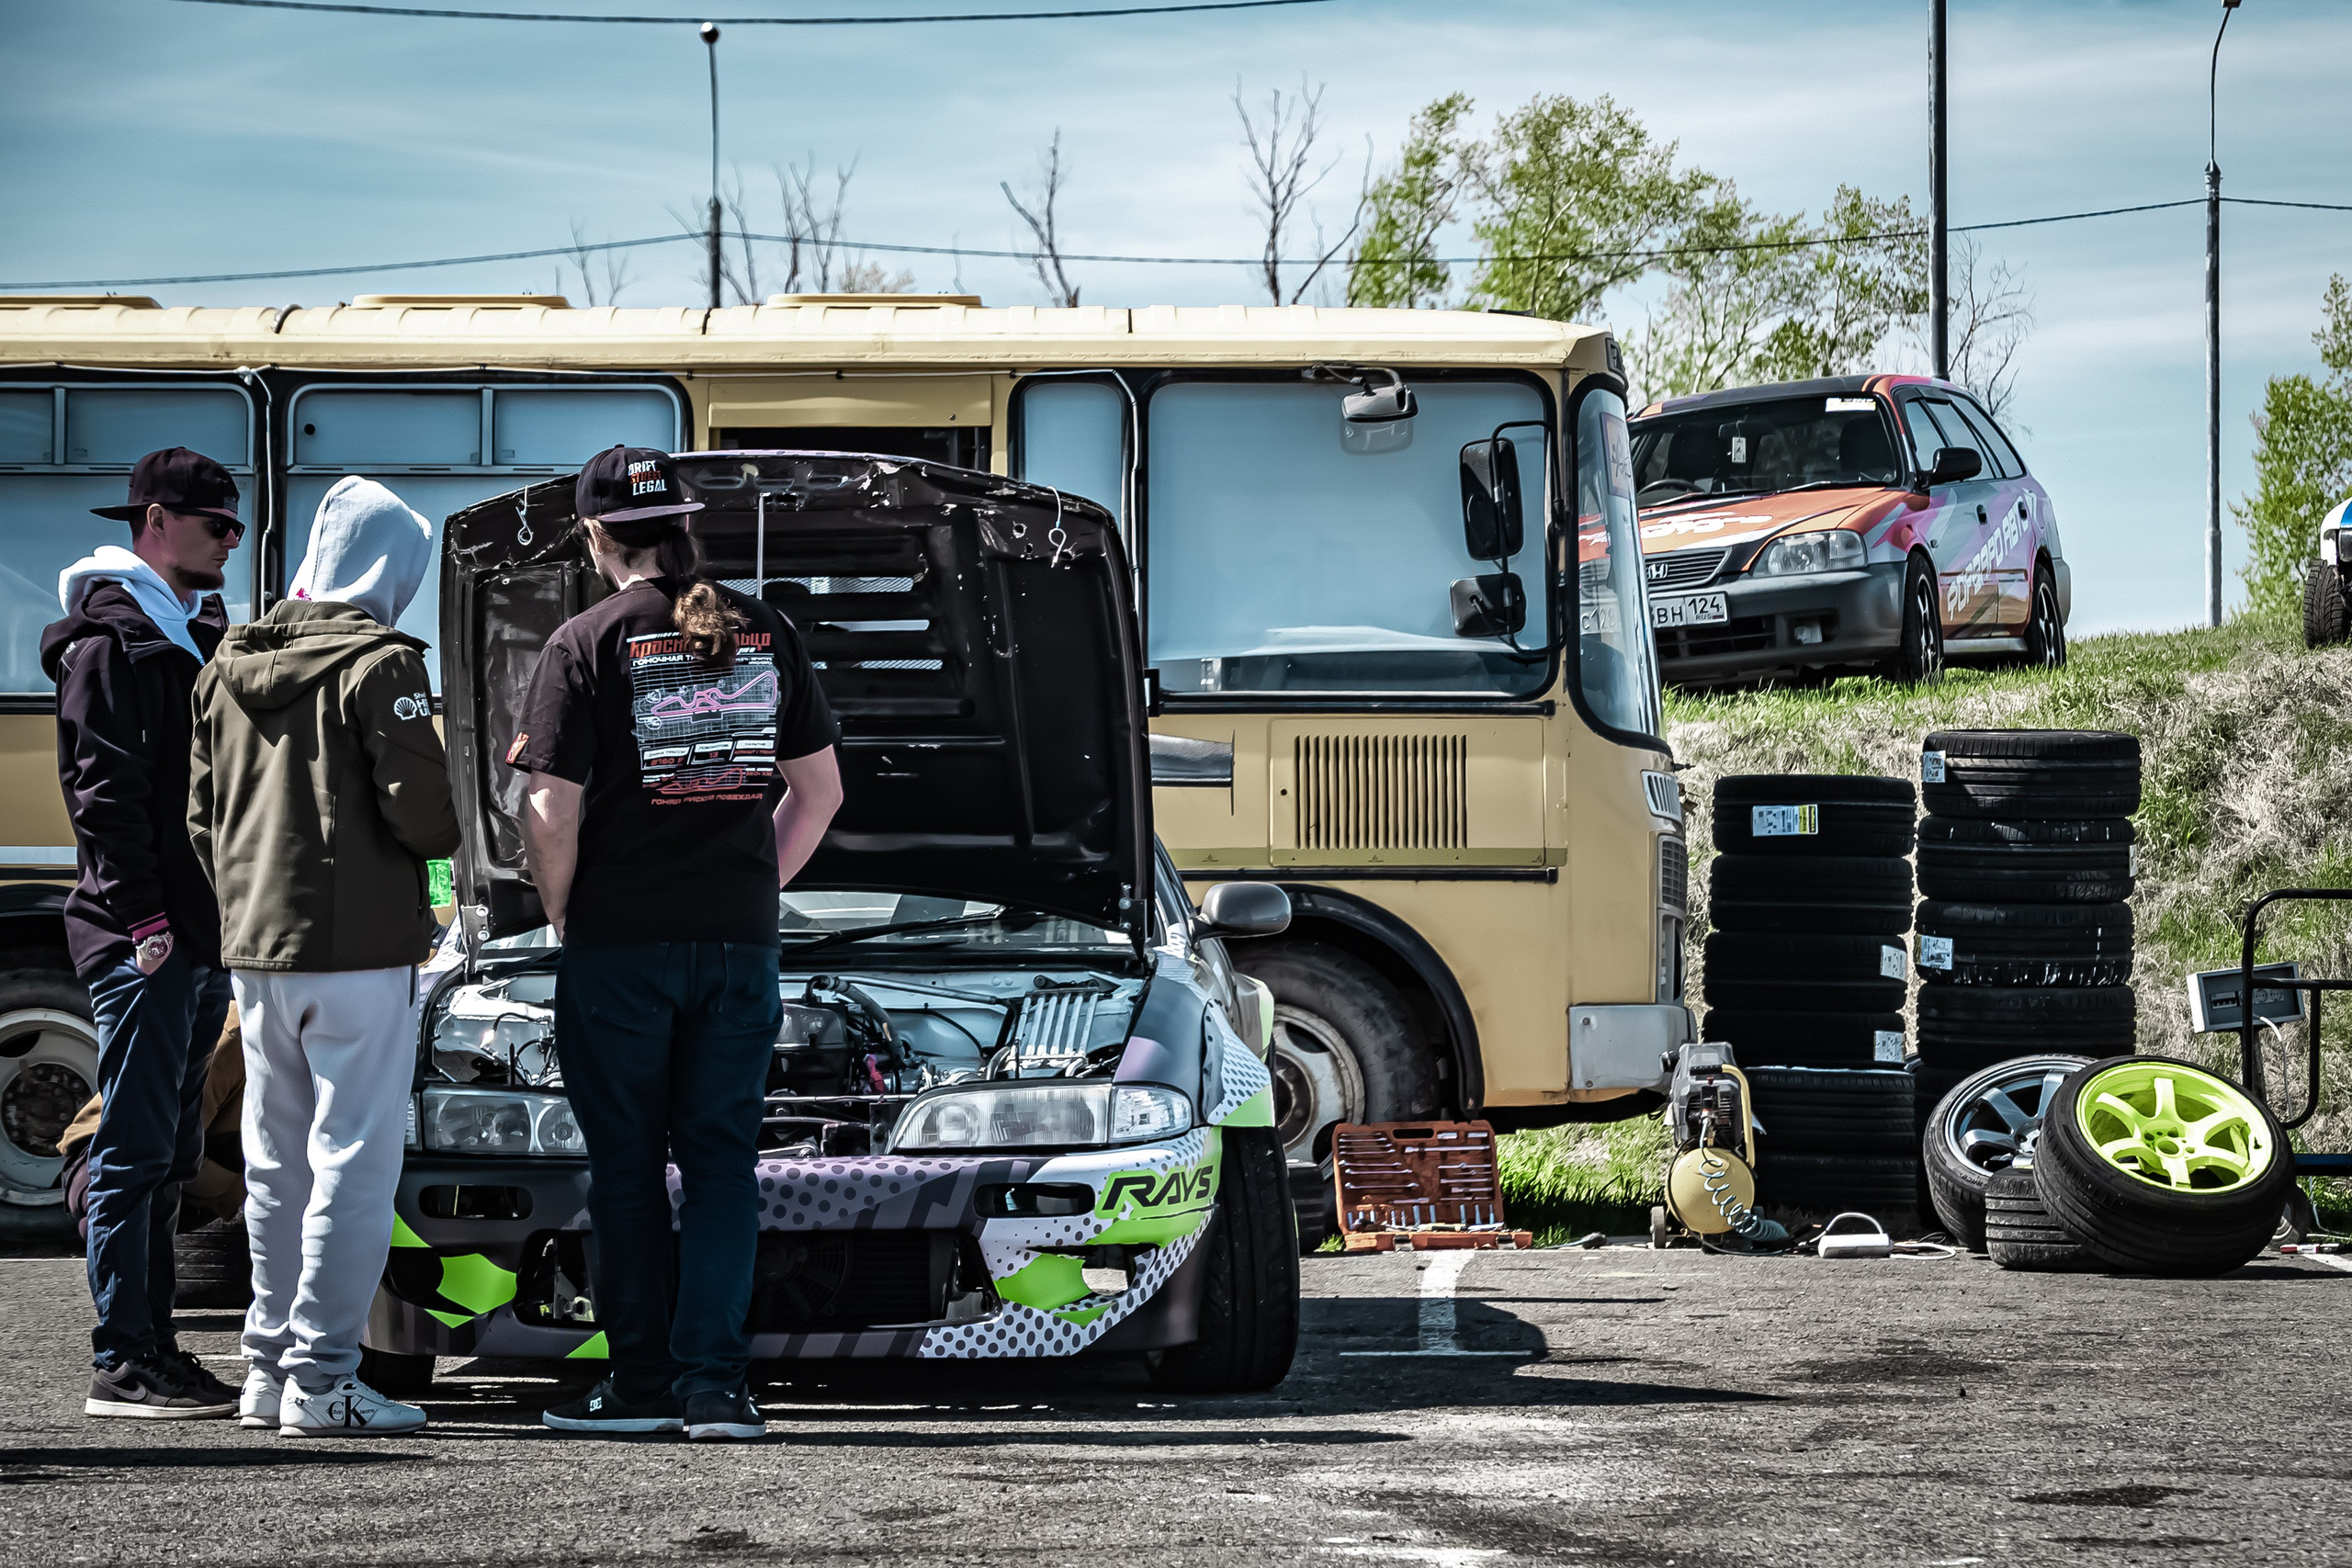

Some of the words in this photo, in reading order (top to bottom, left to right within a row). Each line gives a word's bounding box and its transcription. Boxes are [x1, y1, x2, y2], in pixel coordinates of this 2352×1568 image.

[628, 460, 656, 476] DRIFT
[630, 470, 662, 484] STREET
[632, 479, 667, 496] LEGAL
[1688, 596, 1721, 615] 124
[632, 655, 684, 667] ГОНОЧНАЯ
[1101, 1164, 1214, 1212] RAYS
